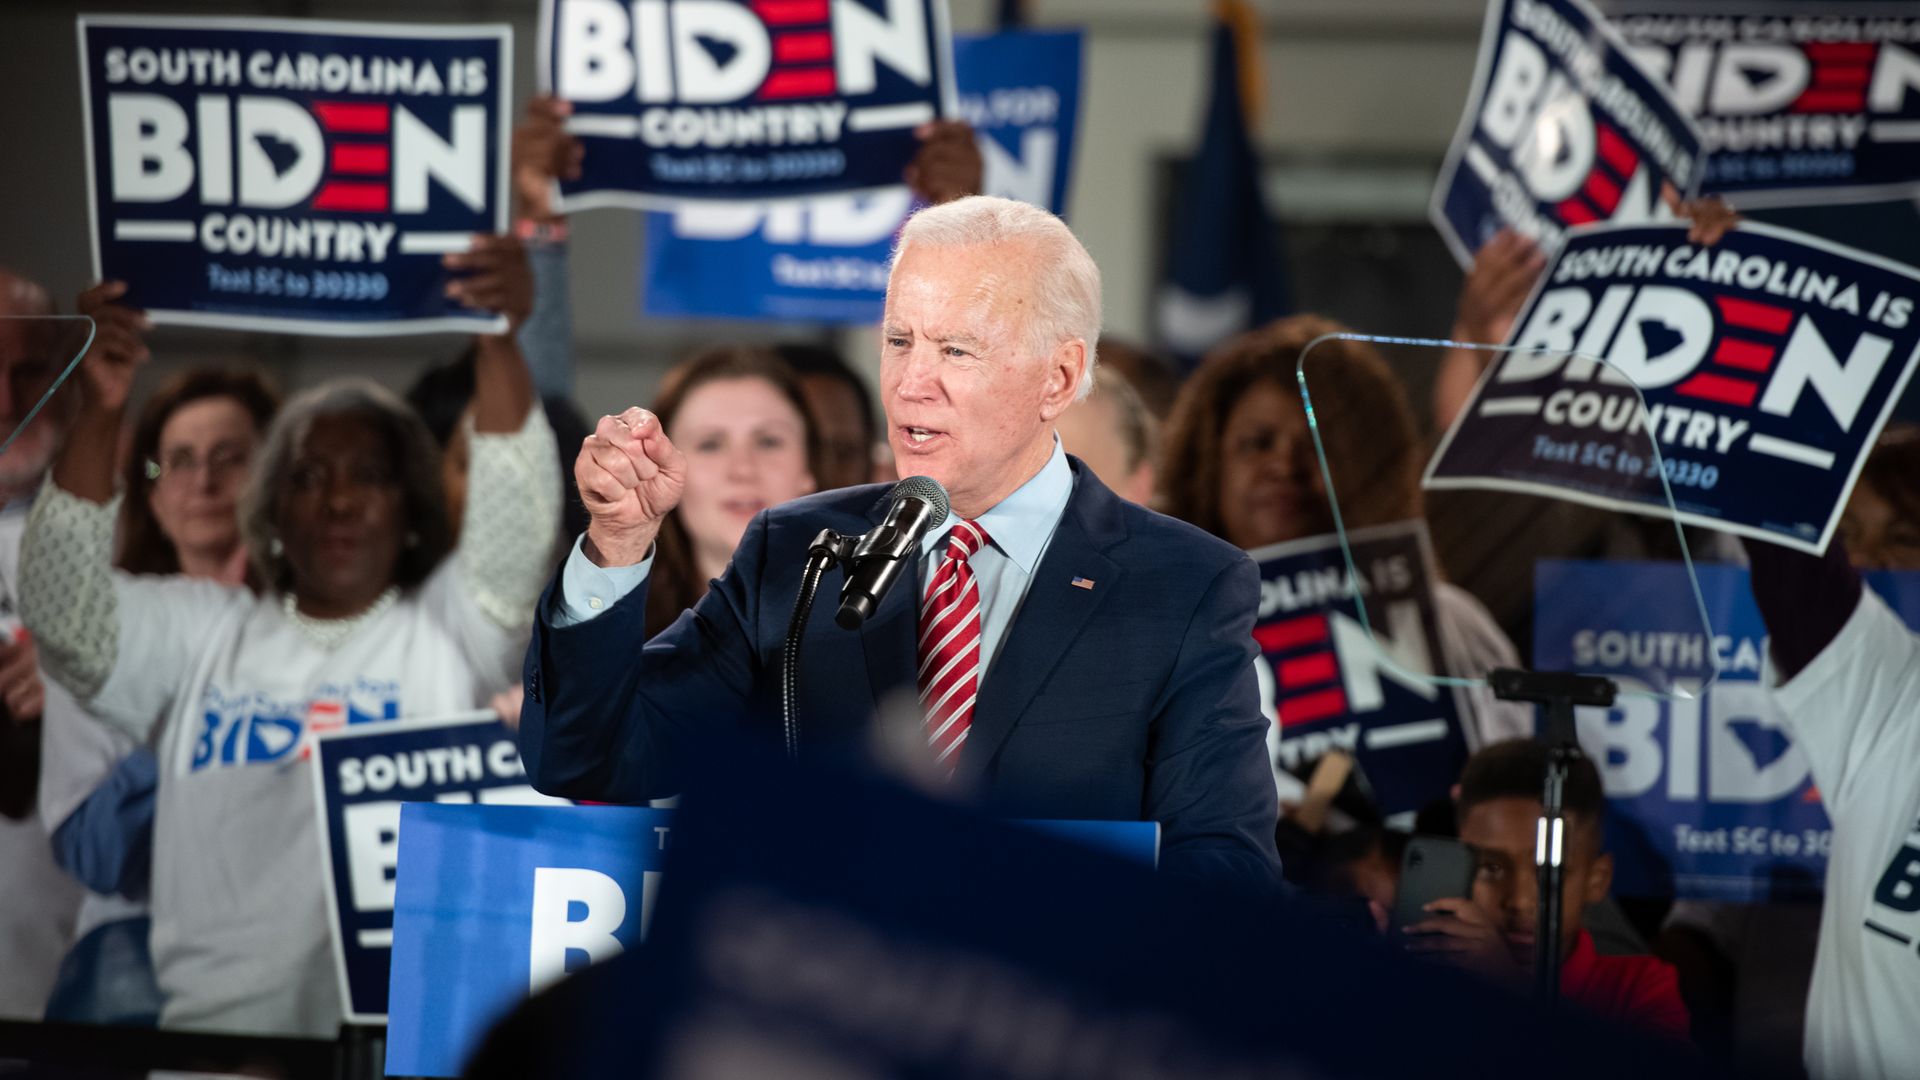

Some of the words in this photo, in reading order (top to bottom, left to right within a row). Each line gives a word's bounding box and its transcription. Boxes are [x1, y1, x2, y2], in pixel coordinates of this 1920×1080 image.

[106, 47, 241, 86] SOUTH
[247, 50, 442, 95] CAROLINA
[449, 57, 488, 96] IS
[557, 0, 932, 101] BIDEN
[640, 101, 848, 148] COUNTRY
[108, 92, 487, 213] BIDEN
[201, 212, 397, 262] COUNTRY
[209, 262, 253, 292] Text
[254, 266, 284, 295] SC
[285, 270, 310, 298] to
[312, 269, 389, 300] 30330
[1555, 245, 1663, 283] SOUTH
[1664, 247, 1859, 317] CAROLINA
[1867, 291, 1917, 330] IS
[1498, 284, 1895, 434] BIDEN
[1543, 389, 1750, 455] COUNTRY
[1532, 433, 1577, 460] Text
[1579, 441, 1615, 470] SC
[1616, 448, 1644, 475] to
[1645, 455, 1720, 489] 30330
[1573, 631, 1703, 668] SOUTH
[1573, 674, 1823, 804] BID
[338, 741, 483, 795] SOUTH
[1675, 824, 1728, 853] Text
[1732, 826, 1769, 855] SC
[1771, 828, 1800, 856] to
